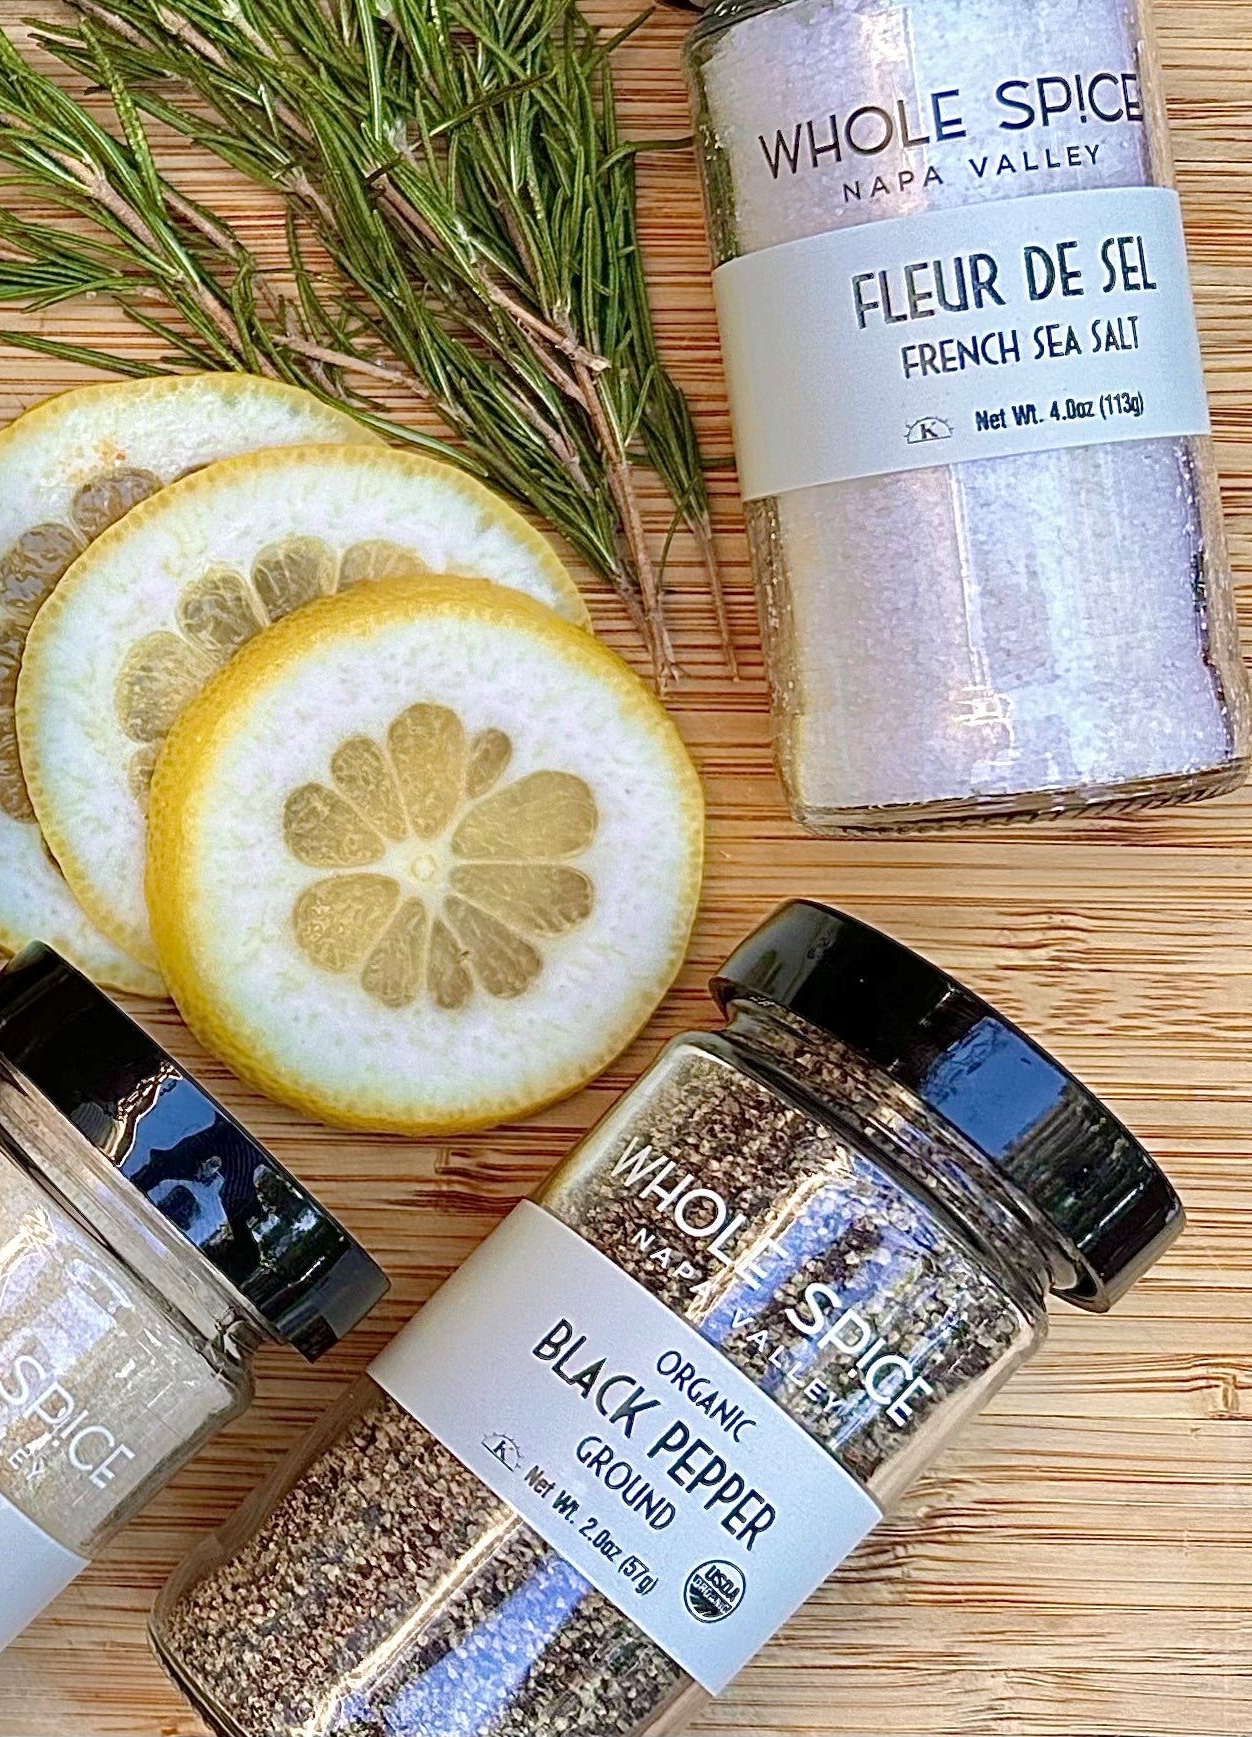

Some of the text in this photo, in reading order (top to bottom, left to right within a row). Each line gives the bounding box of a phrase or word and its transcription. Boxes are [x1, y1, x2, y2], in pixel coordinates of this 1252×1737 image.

[758, 89, 967, 179] WHOLE
[843, 144, 1100, 202] NAPA VALLEY
[851, 235, 1157, 329] FLEUR DE SEL
[901, 315, 1139, 379] FRENCH SEA SALT
[975, 391, 1145, 432] Net Wt. 4.0oz (113g)
[610, 1136, 789, 1291] WHOLE
[630, 1227, 846, 1413] NAPA VALLEY
[532, 1318, 777, 1552] BLACK PEPPER
[656, 1350, 757, 1443] ORGANIC
[575, 1435, 677, 1531] GROUND
[524, 1464, 659, 1596] Net Wt. 2.0oz (57g)
[704, 1564, 741, 1603] USDA
